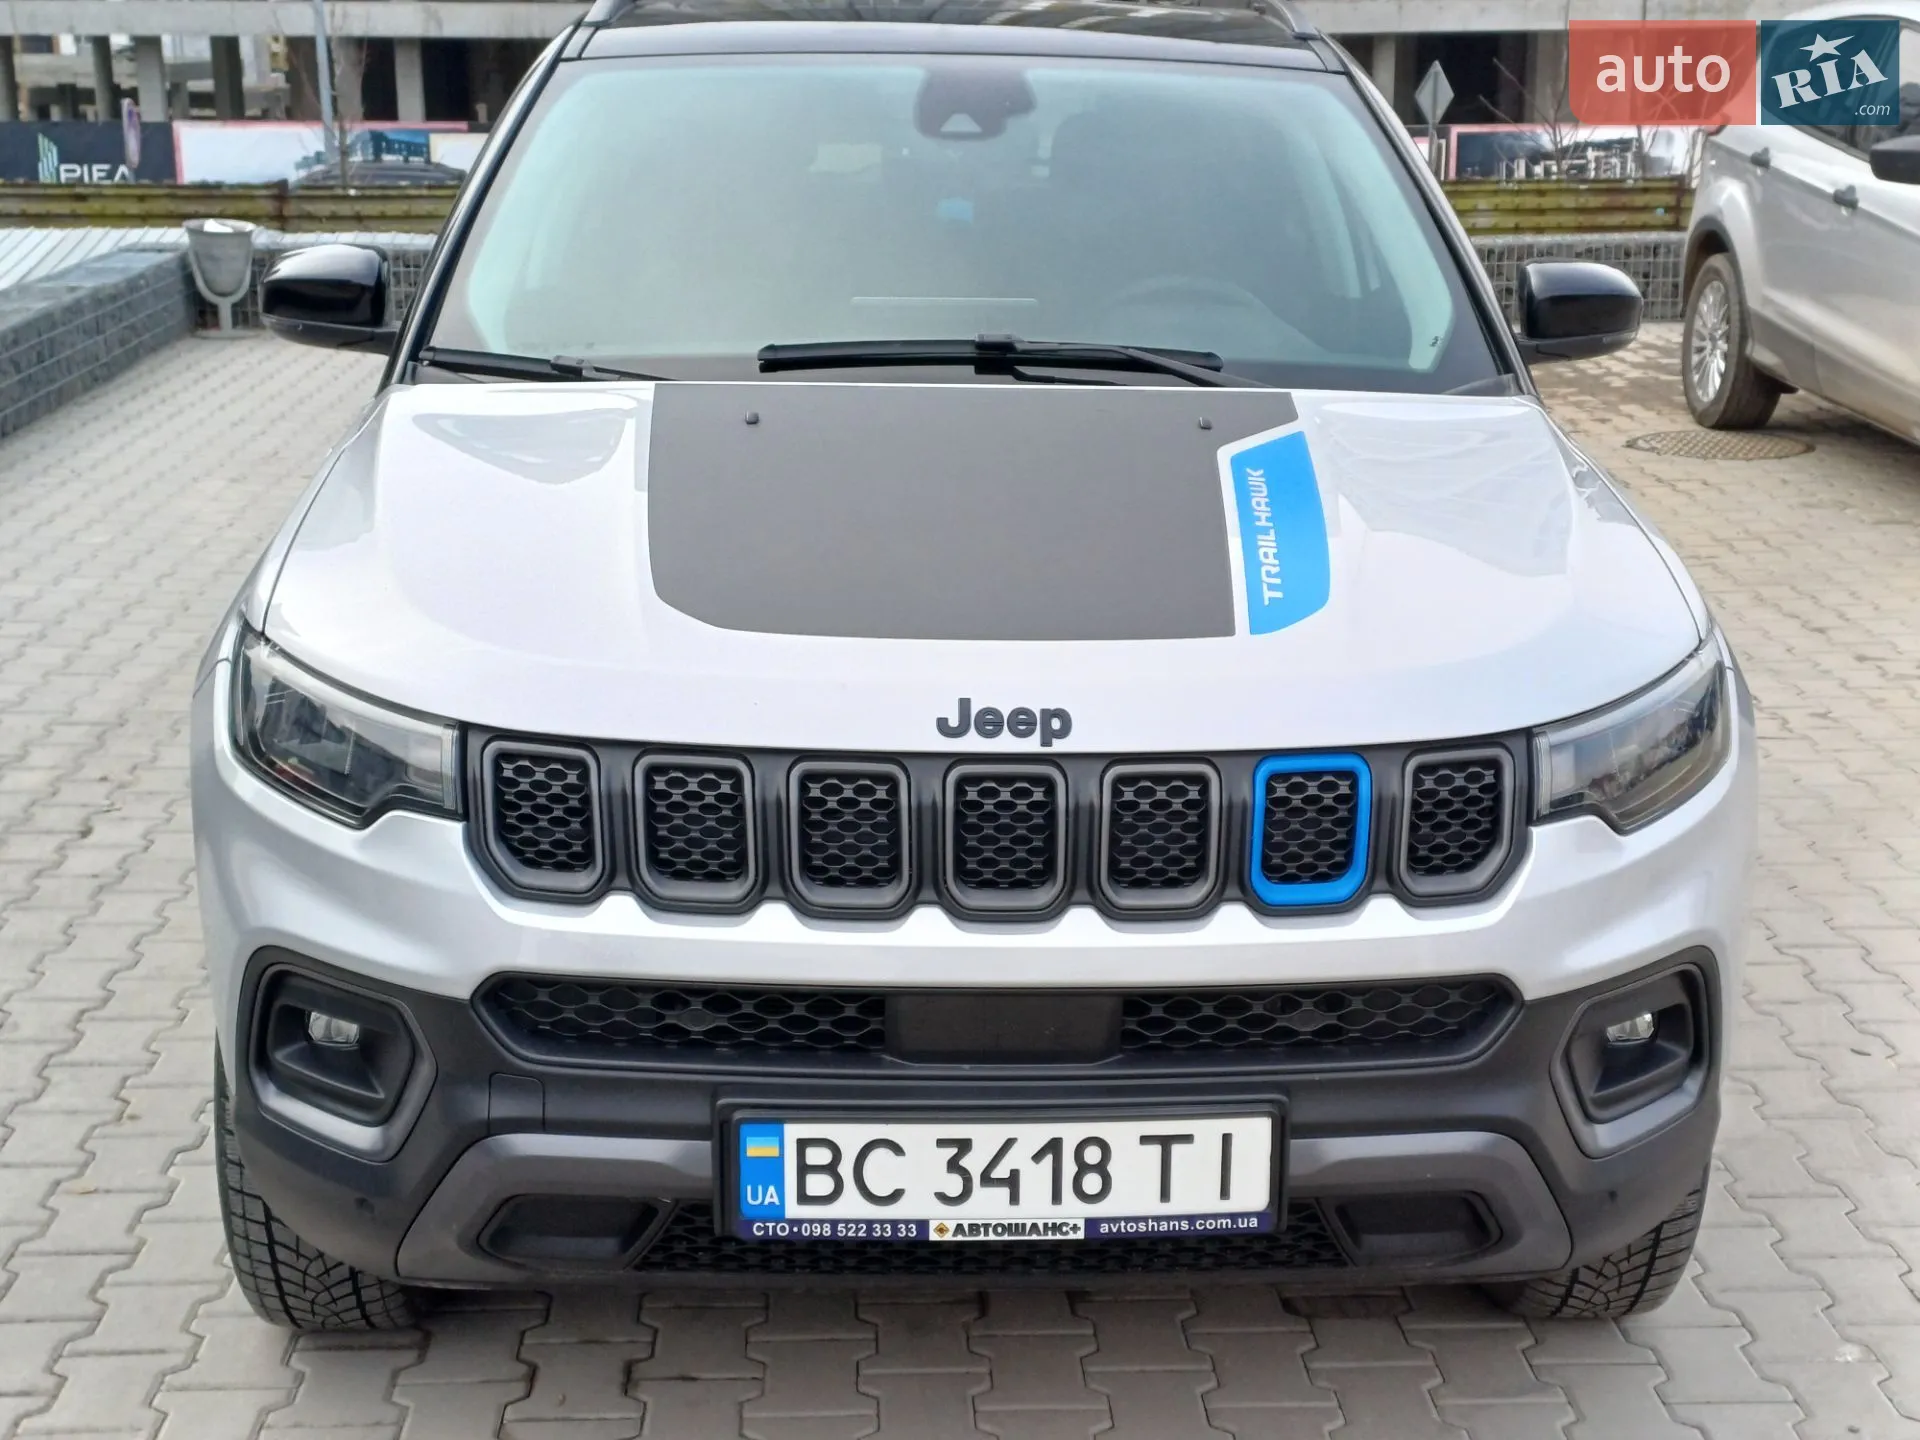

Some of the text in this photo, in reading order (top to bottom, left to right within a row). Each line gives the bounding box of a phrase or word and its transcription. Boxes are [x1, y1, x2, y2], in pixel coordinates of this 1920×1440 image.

[1246, 467, 1284, 606] TRAILHAWK
[936, 697, 1073, 747] Jeep
[795, 1137, 907, 1207] BC
[933, 1136, 1112, 1206] 3418
[746, 1184, 780, 1206] UA
[836, 1222, 867, 1238] 522
[872, 1223, 892, 1237] 33
[897, 1223, 917, 1237] 33
[1100, 1216, 1258, 1233] avtoshans.com.ua
